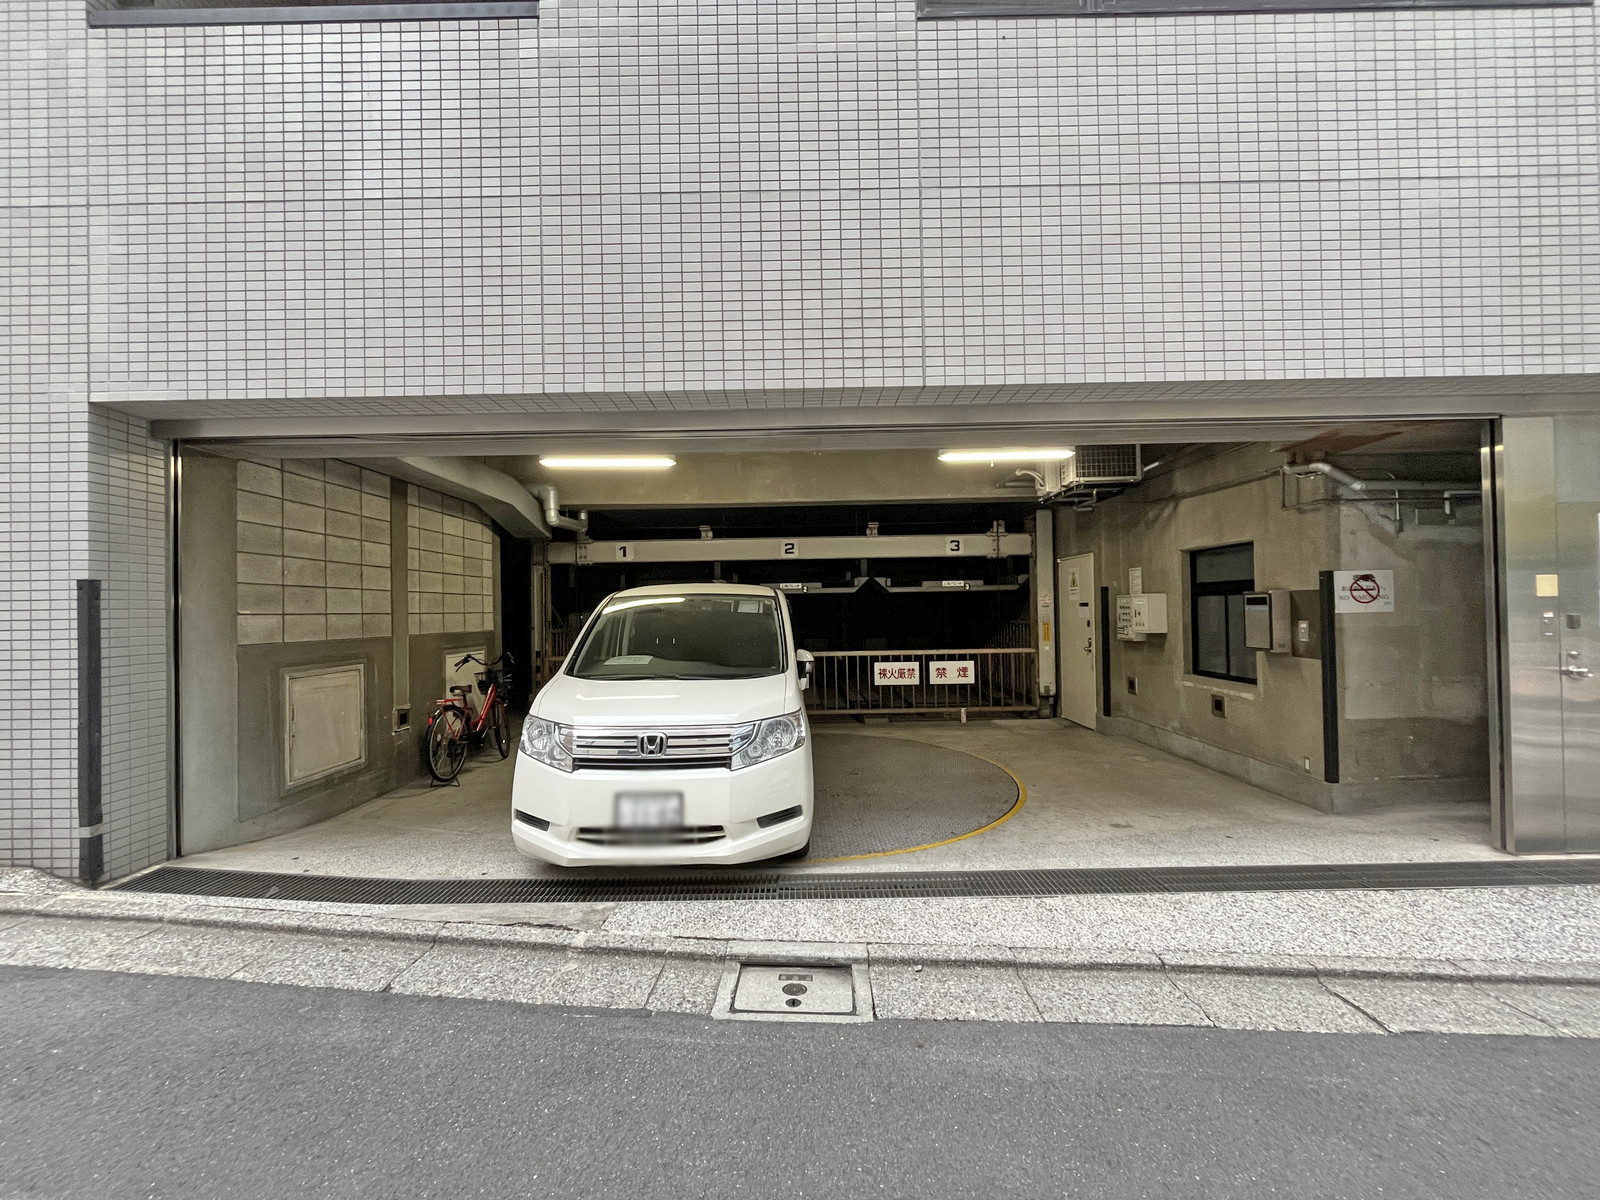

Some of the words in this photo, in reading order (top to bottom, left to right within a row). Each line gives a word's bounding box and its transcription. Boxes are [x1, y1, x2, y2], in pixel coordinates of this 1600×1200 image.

[784, 543, 794, 554] 2
[950, 540, 960, 551] 3
[619, 546, 627, 558] 1
[878, 667, 916, 680] 裸火厳禁
[935, 666, 969, 679] 禁煙
